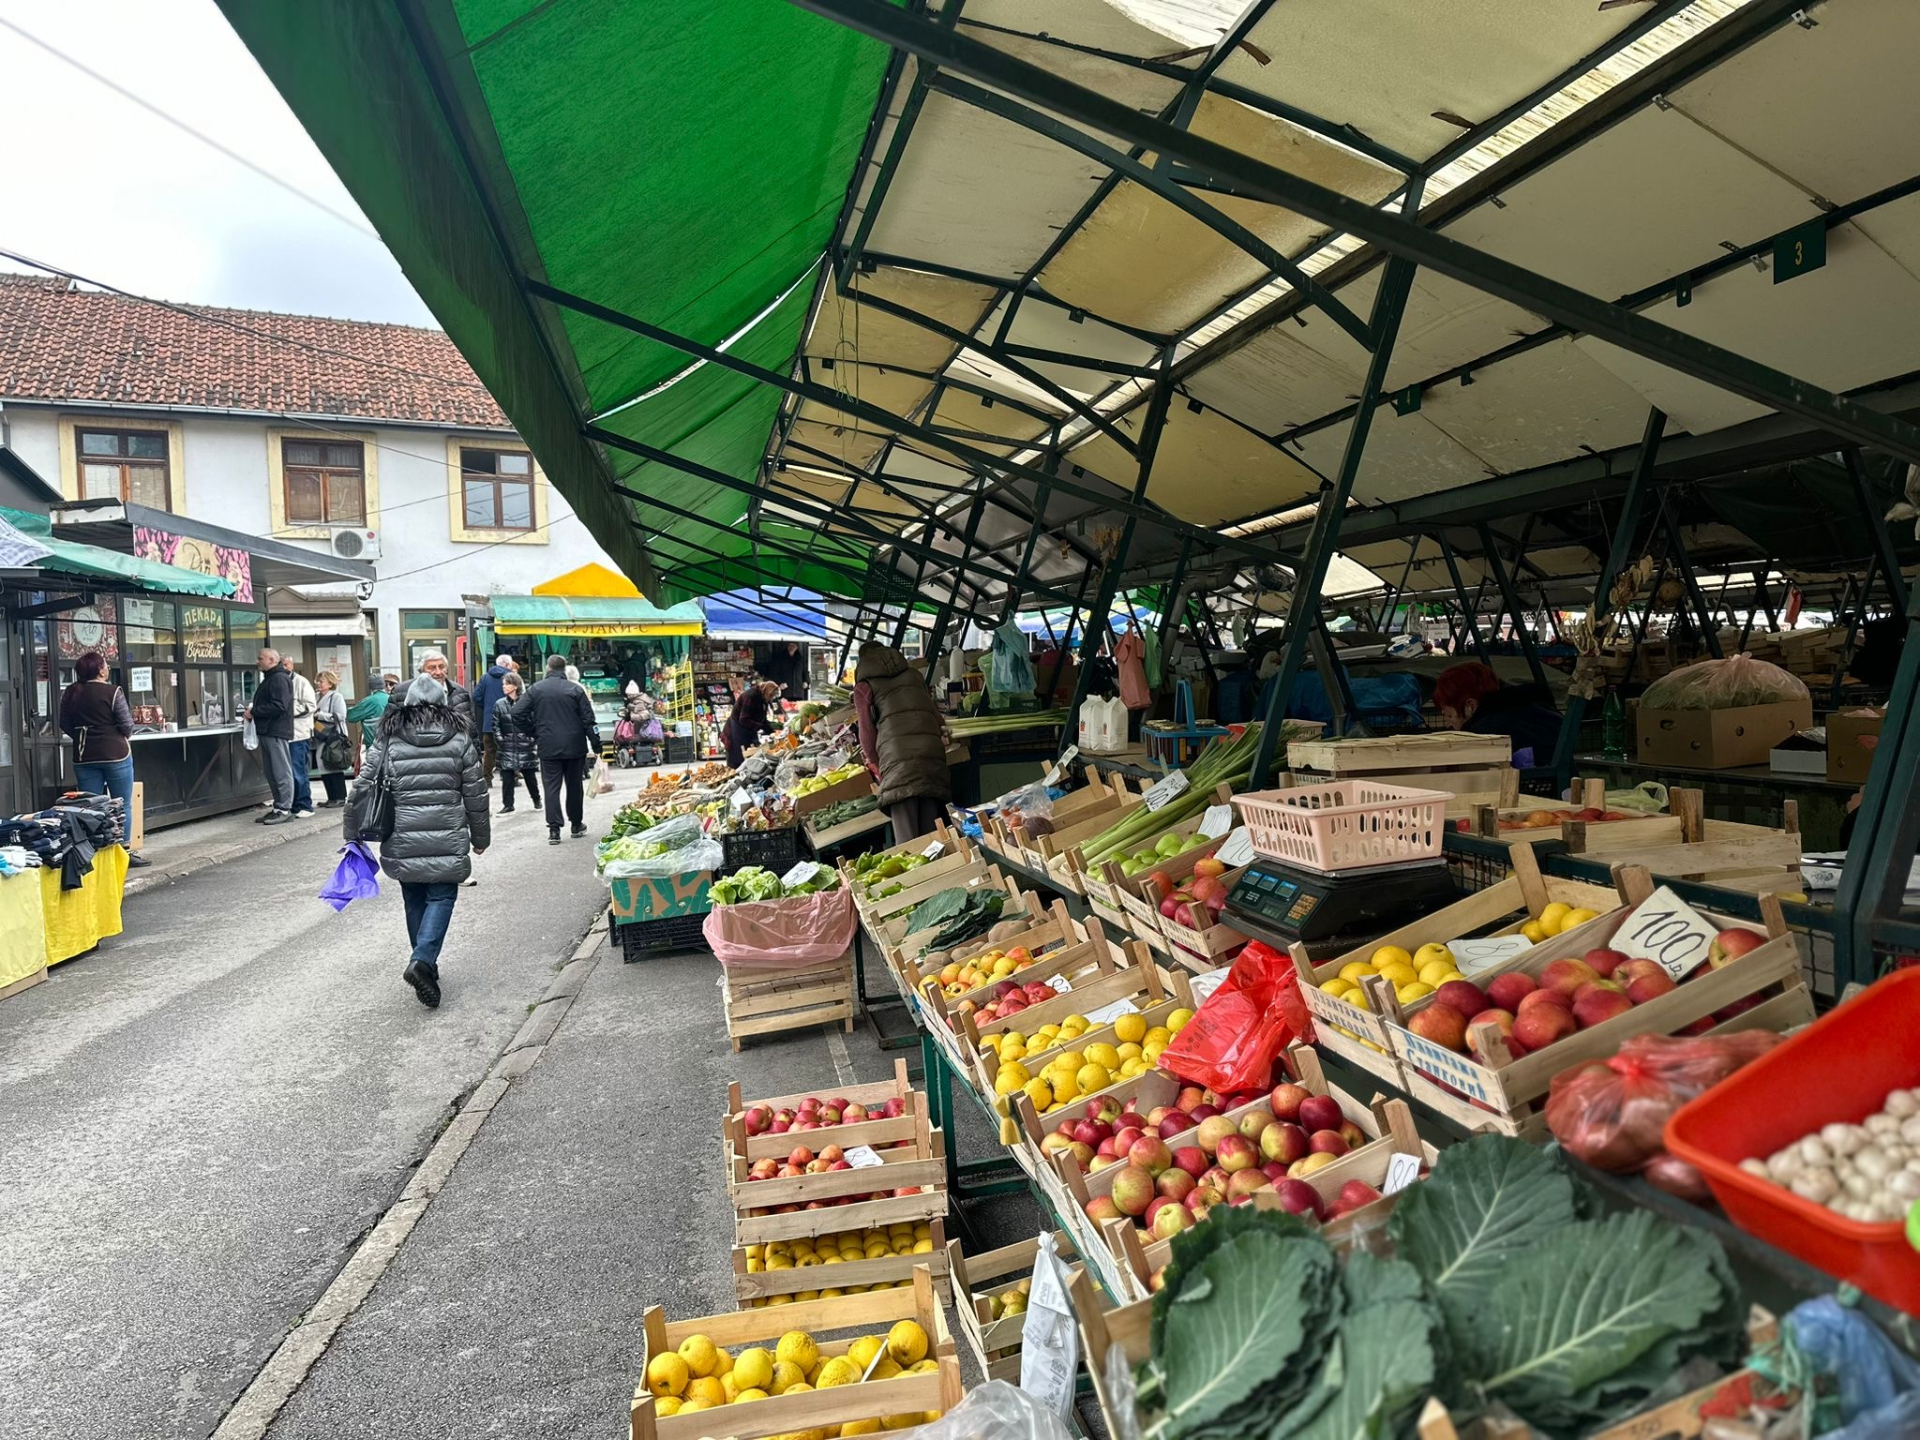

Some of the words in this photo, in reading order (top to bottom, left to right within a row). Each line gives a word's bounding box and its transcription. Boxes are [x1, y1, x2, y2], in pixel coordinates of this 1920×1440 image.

[1794, 240, 1803, 266] 3
[184, 607, 222, 630] ПЕКАРА
[1630, 910, 1707, 965] 100
[1311, 987, 1367, 1025] Плантажа
[1313, 1001, 1375, 1042] Станковић
[1404, 1031, 1479, 1081] Плантажа
[1406, 1048, 1487, 1101] Станковић
